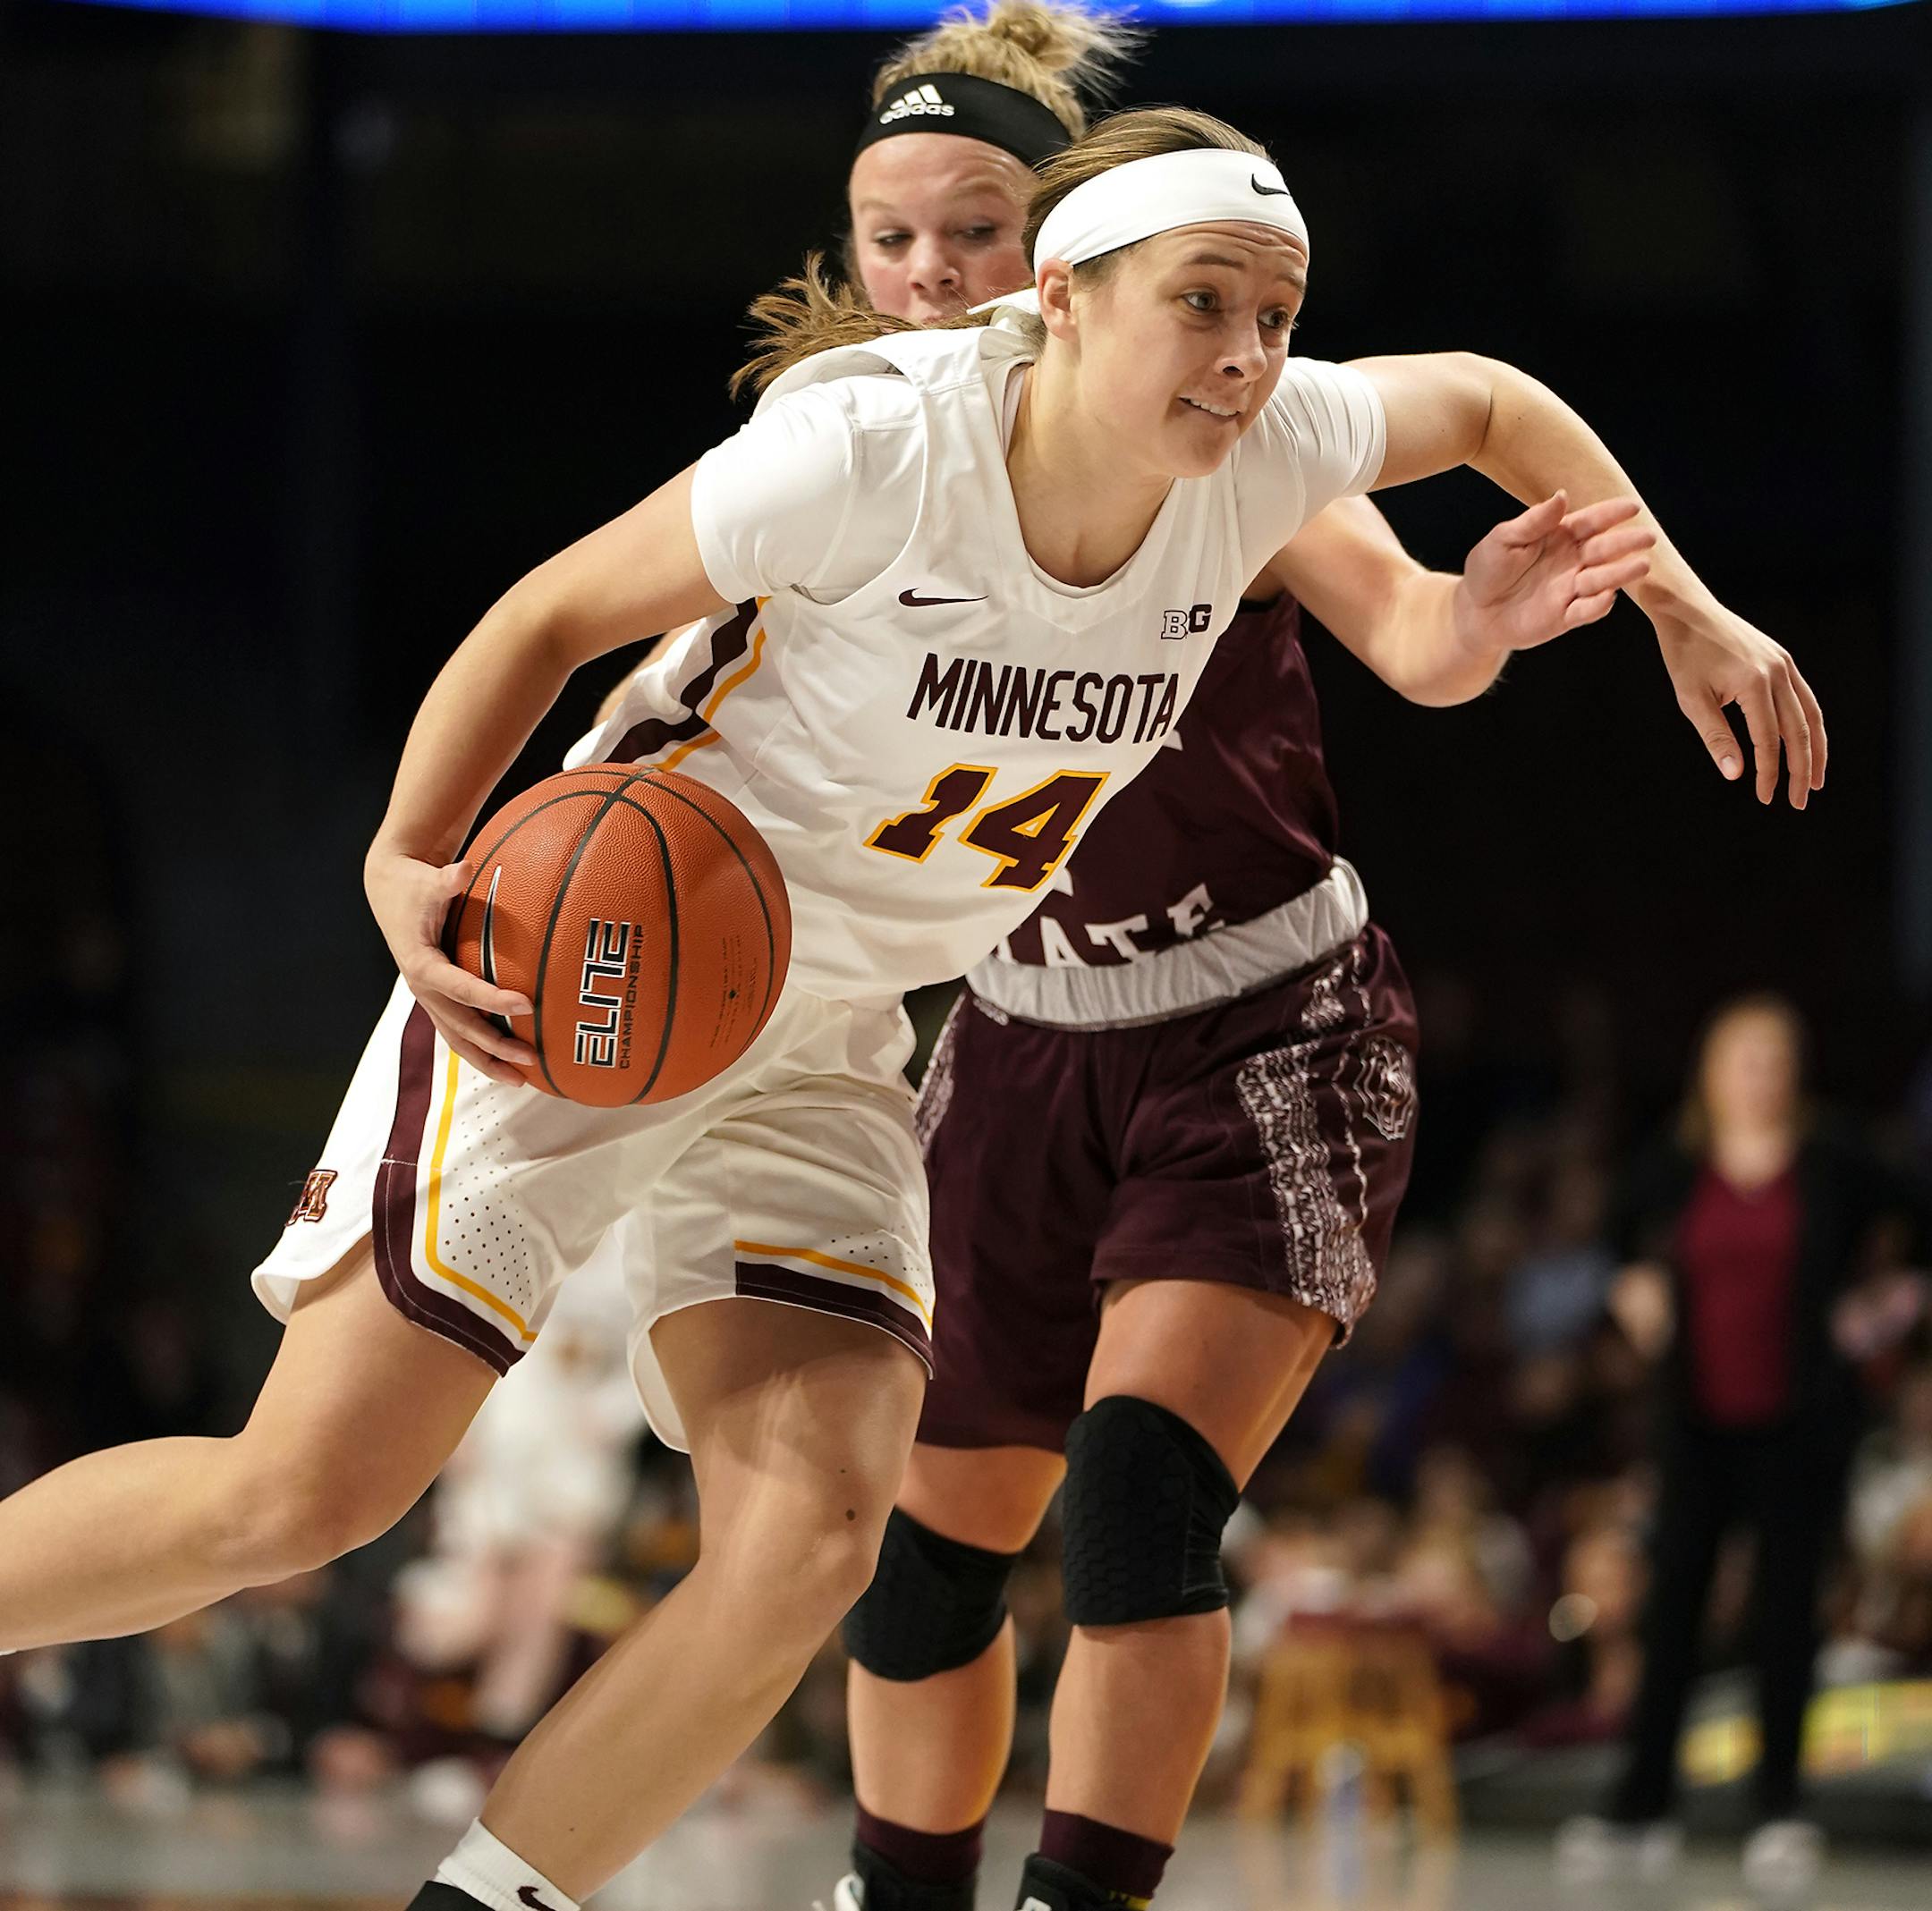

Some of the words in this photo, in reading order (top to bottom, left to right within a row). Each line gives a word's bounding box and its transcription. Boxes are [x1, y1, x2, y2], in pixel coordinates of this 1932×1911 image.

[879, 103, 954, 124] adidas
[906, 652, 1179, 744] MINNESOTA
[862, 763, 1111, 892] 14
[996, 883, 1225, 968] ATE
[573, 917, 631, 1069] ELITE
[619, 925, 644, 1070] CHAMPIONSHIP
